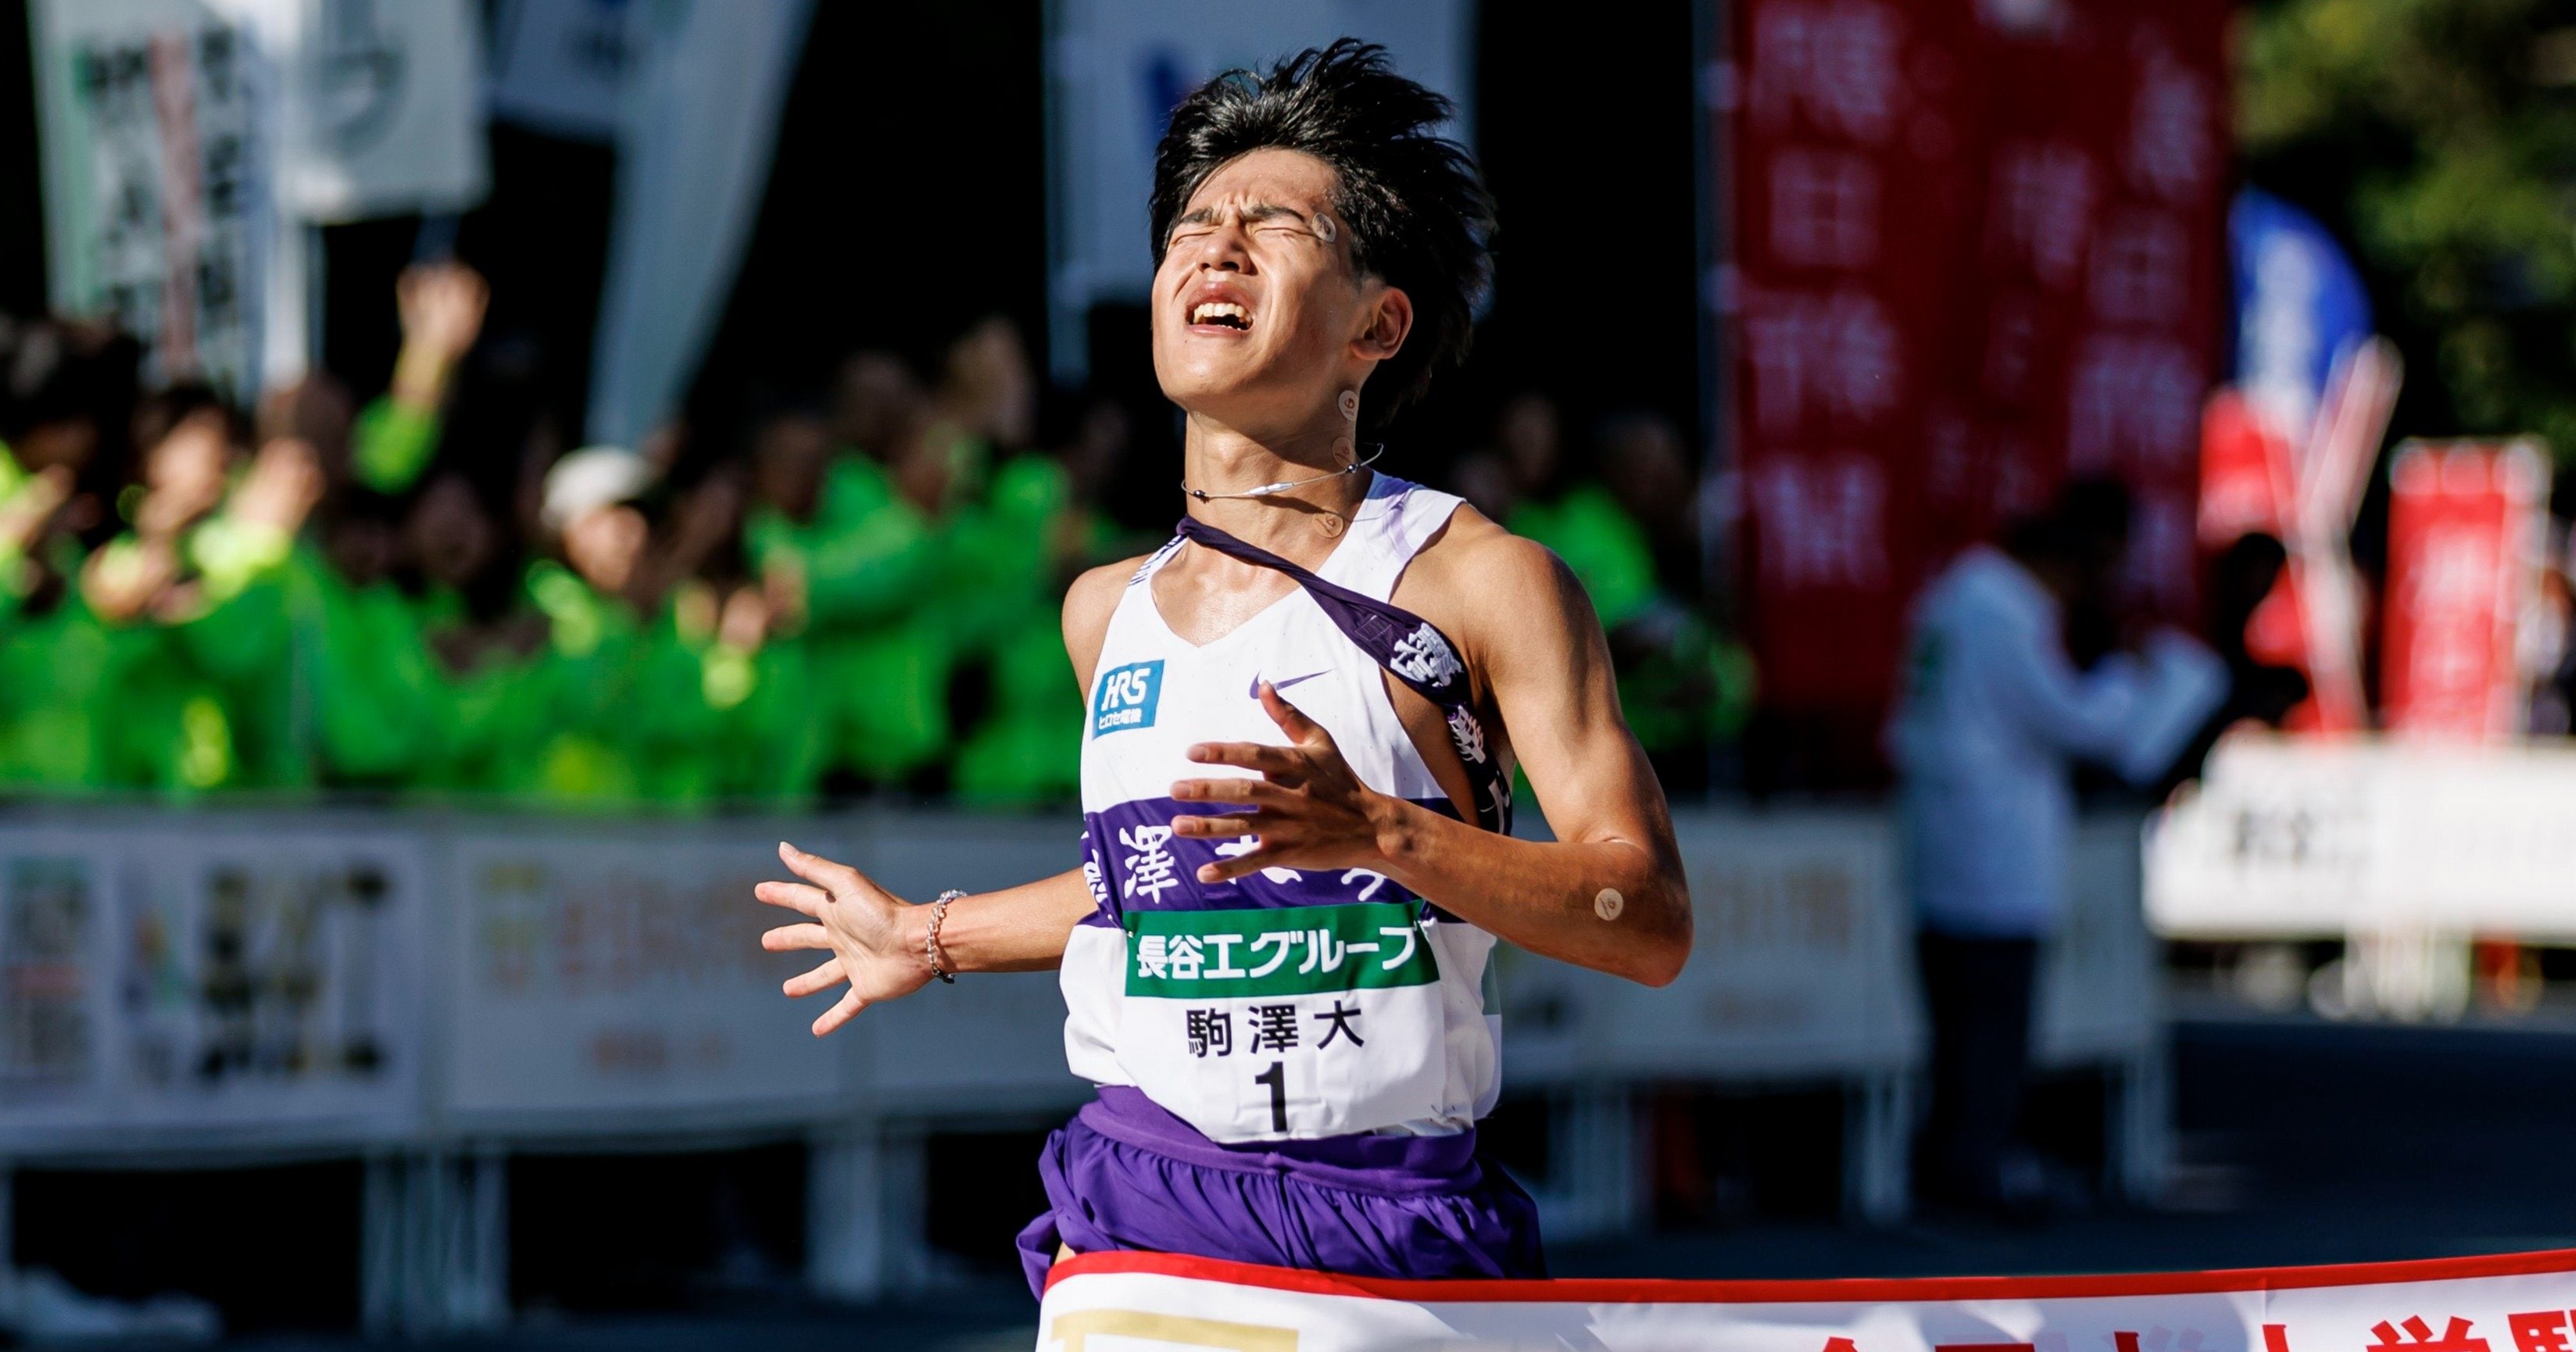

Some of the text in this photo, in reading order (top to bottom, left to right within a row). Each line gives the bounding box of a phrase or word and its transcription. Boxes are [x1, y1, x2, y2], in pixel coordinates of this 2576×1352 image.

[1100, 667, 1150, 712] HRS
[1136, 920, 1418, 980] 長谷工グループ
[1186, 1000, 1365, 1058] 駒澤大
[1254, 1060, 1288, 1132] 1
